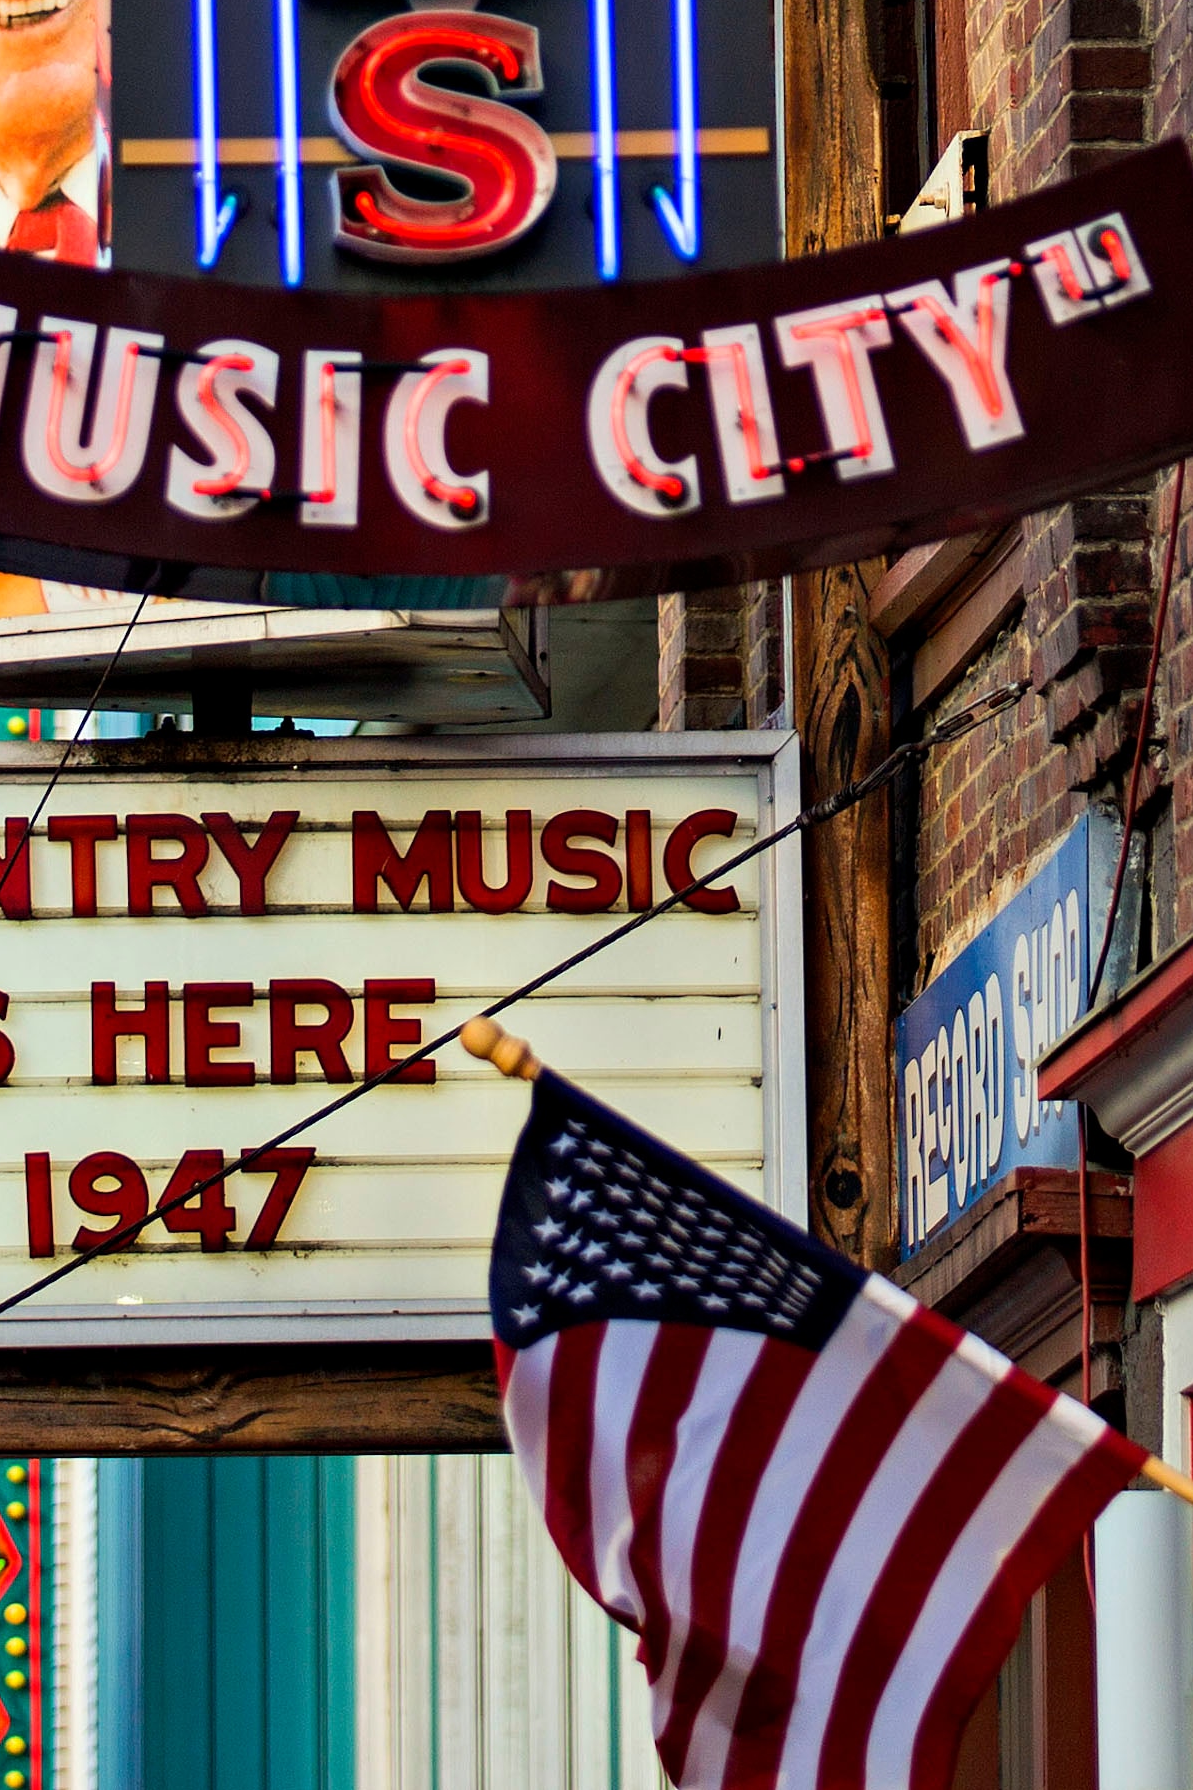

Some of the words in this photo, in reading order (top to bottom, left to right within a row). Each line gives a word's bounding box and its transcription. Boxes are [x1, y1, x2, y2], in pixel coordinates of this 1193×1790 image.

[351, 809, 741, 916] MUSIC
[91, 978, 436, 1087] HERE
[905, 972, 1005, 1246] RECORD
[25, 1146, 316, 1259] 1947
